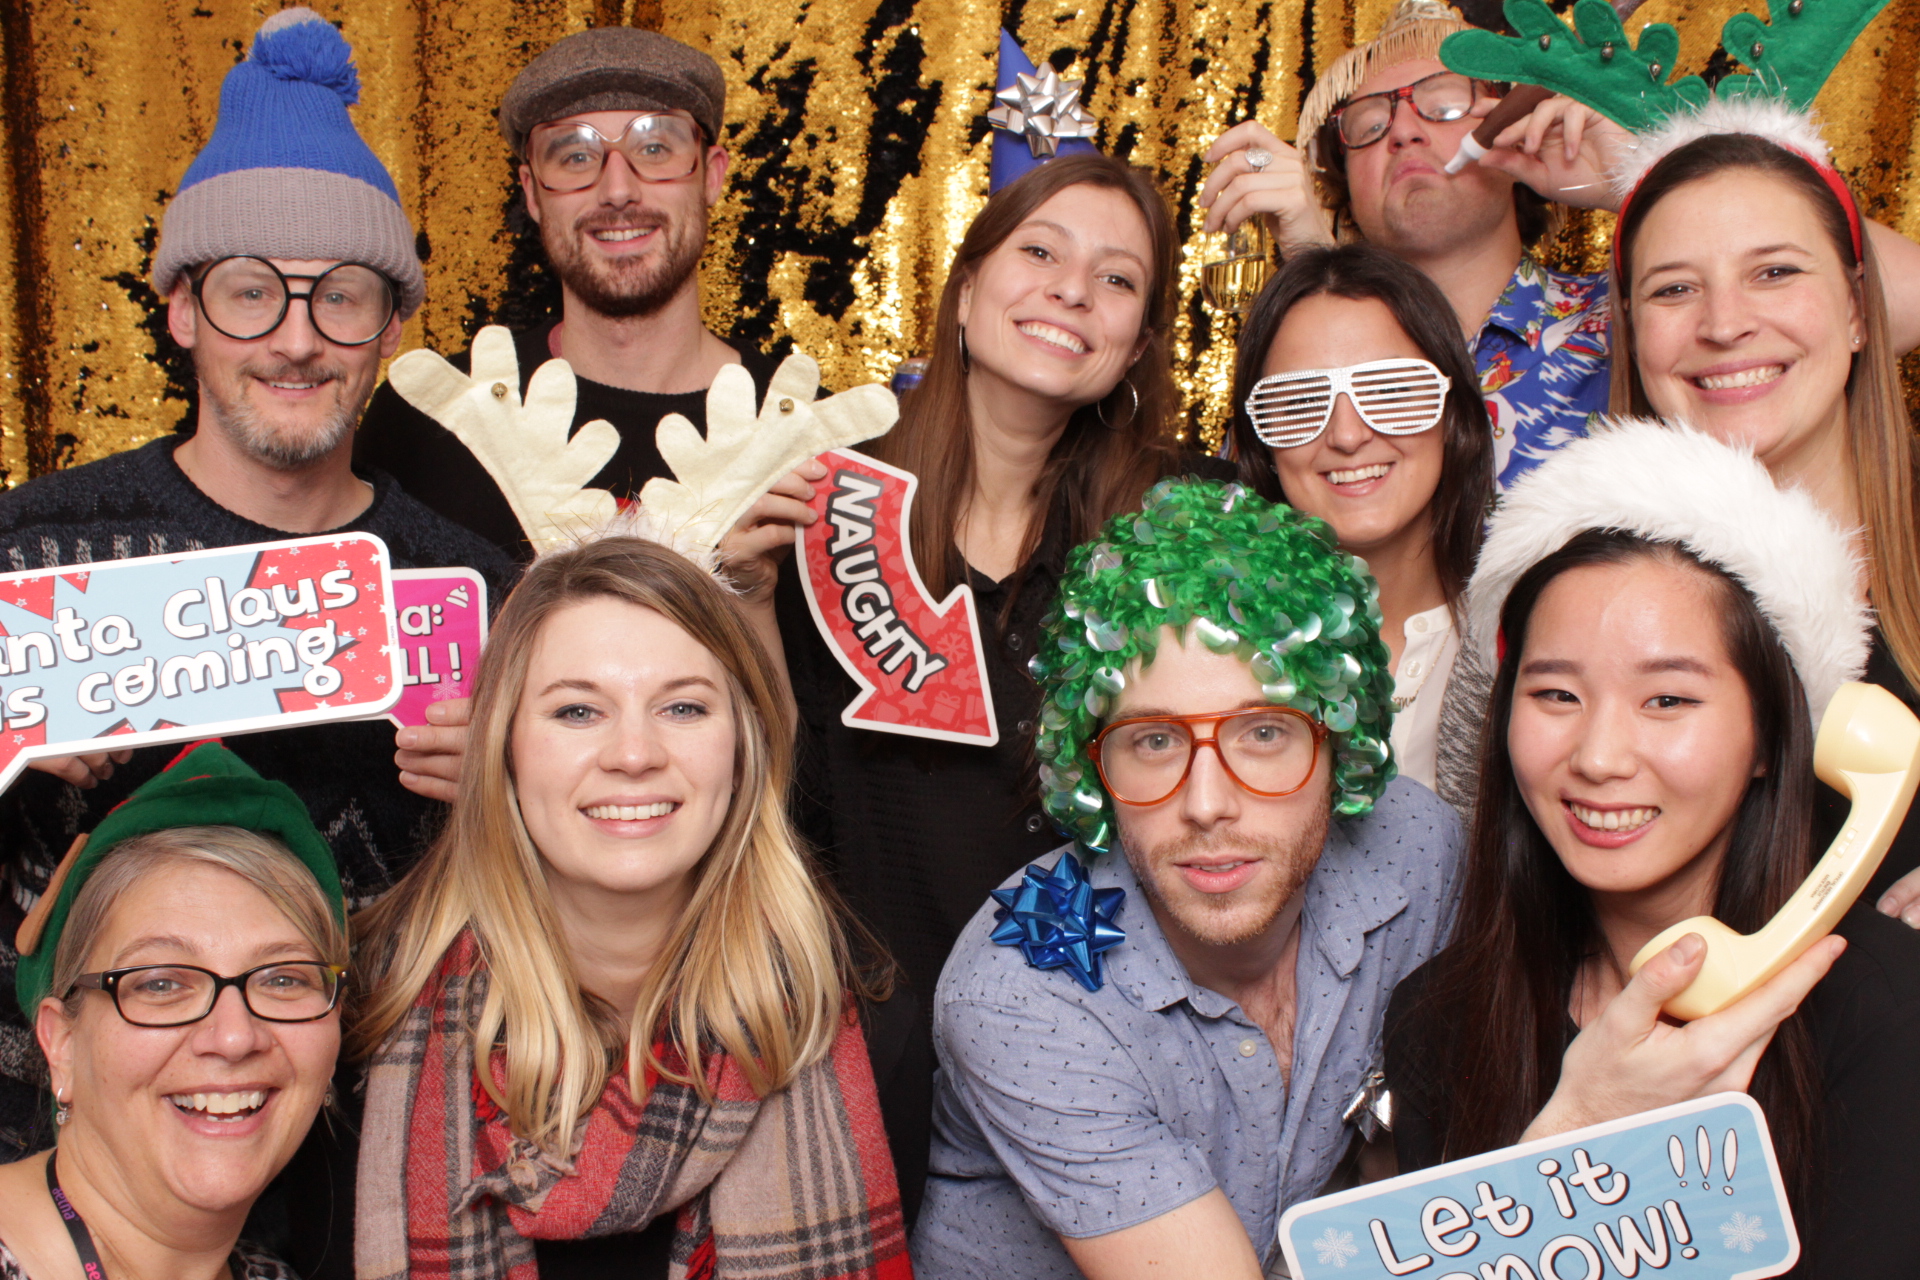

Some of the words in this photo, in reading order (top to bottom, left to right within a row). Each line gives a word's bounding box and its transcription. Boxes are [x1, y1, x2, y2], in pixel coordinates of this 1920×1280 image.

[0, 606, 139, 677] nta
[163, 569, 359, 640] Claus
[396, 604, 444, 637] a:
[829, 473, 947, 693] NAUGHTY
[0, 685, 48, 732] s
[77, 619, 343, 714] coming
[1368, 1181, 1532, 1276] Let
[1537, 1148, 1630, 1219] it
